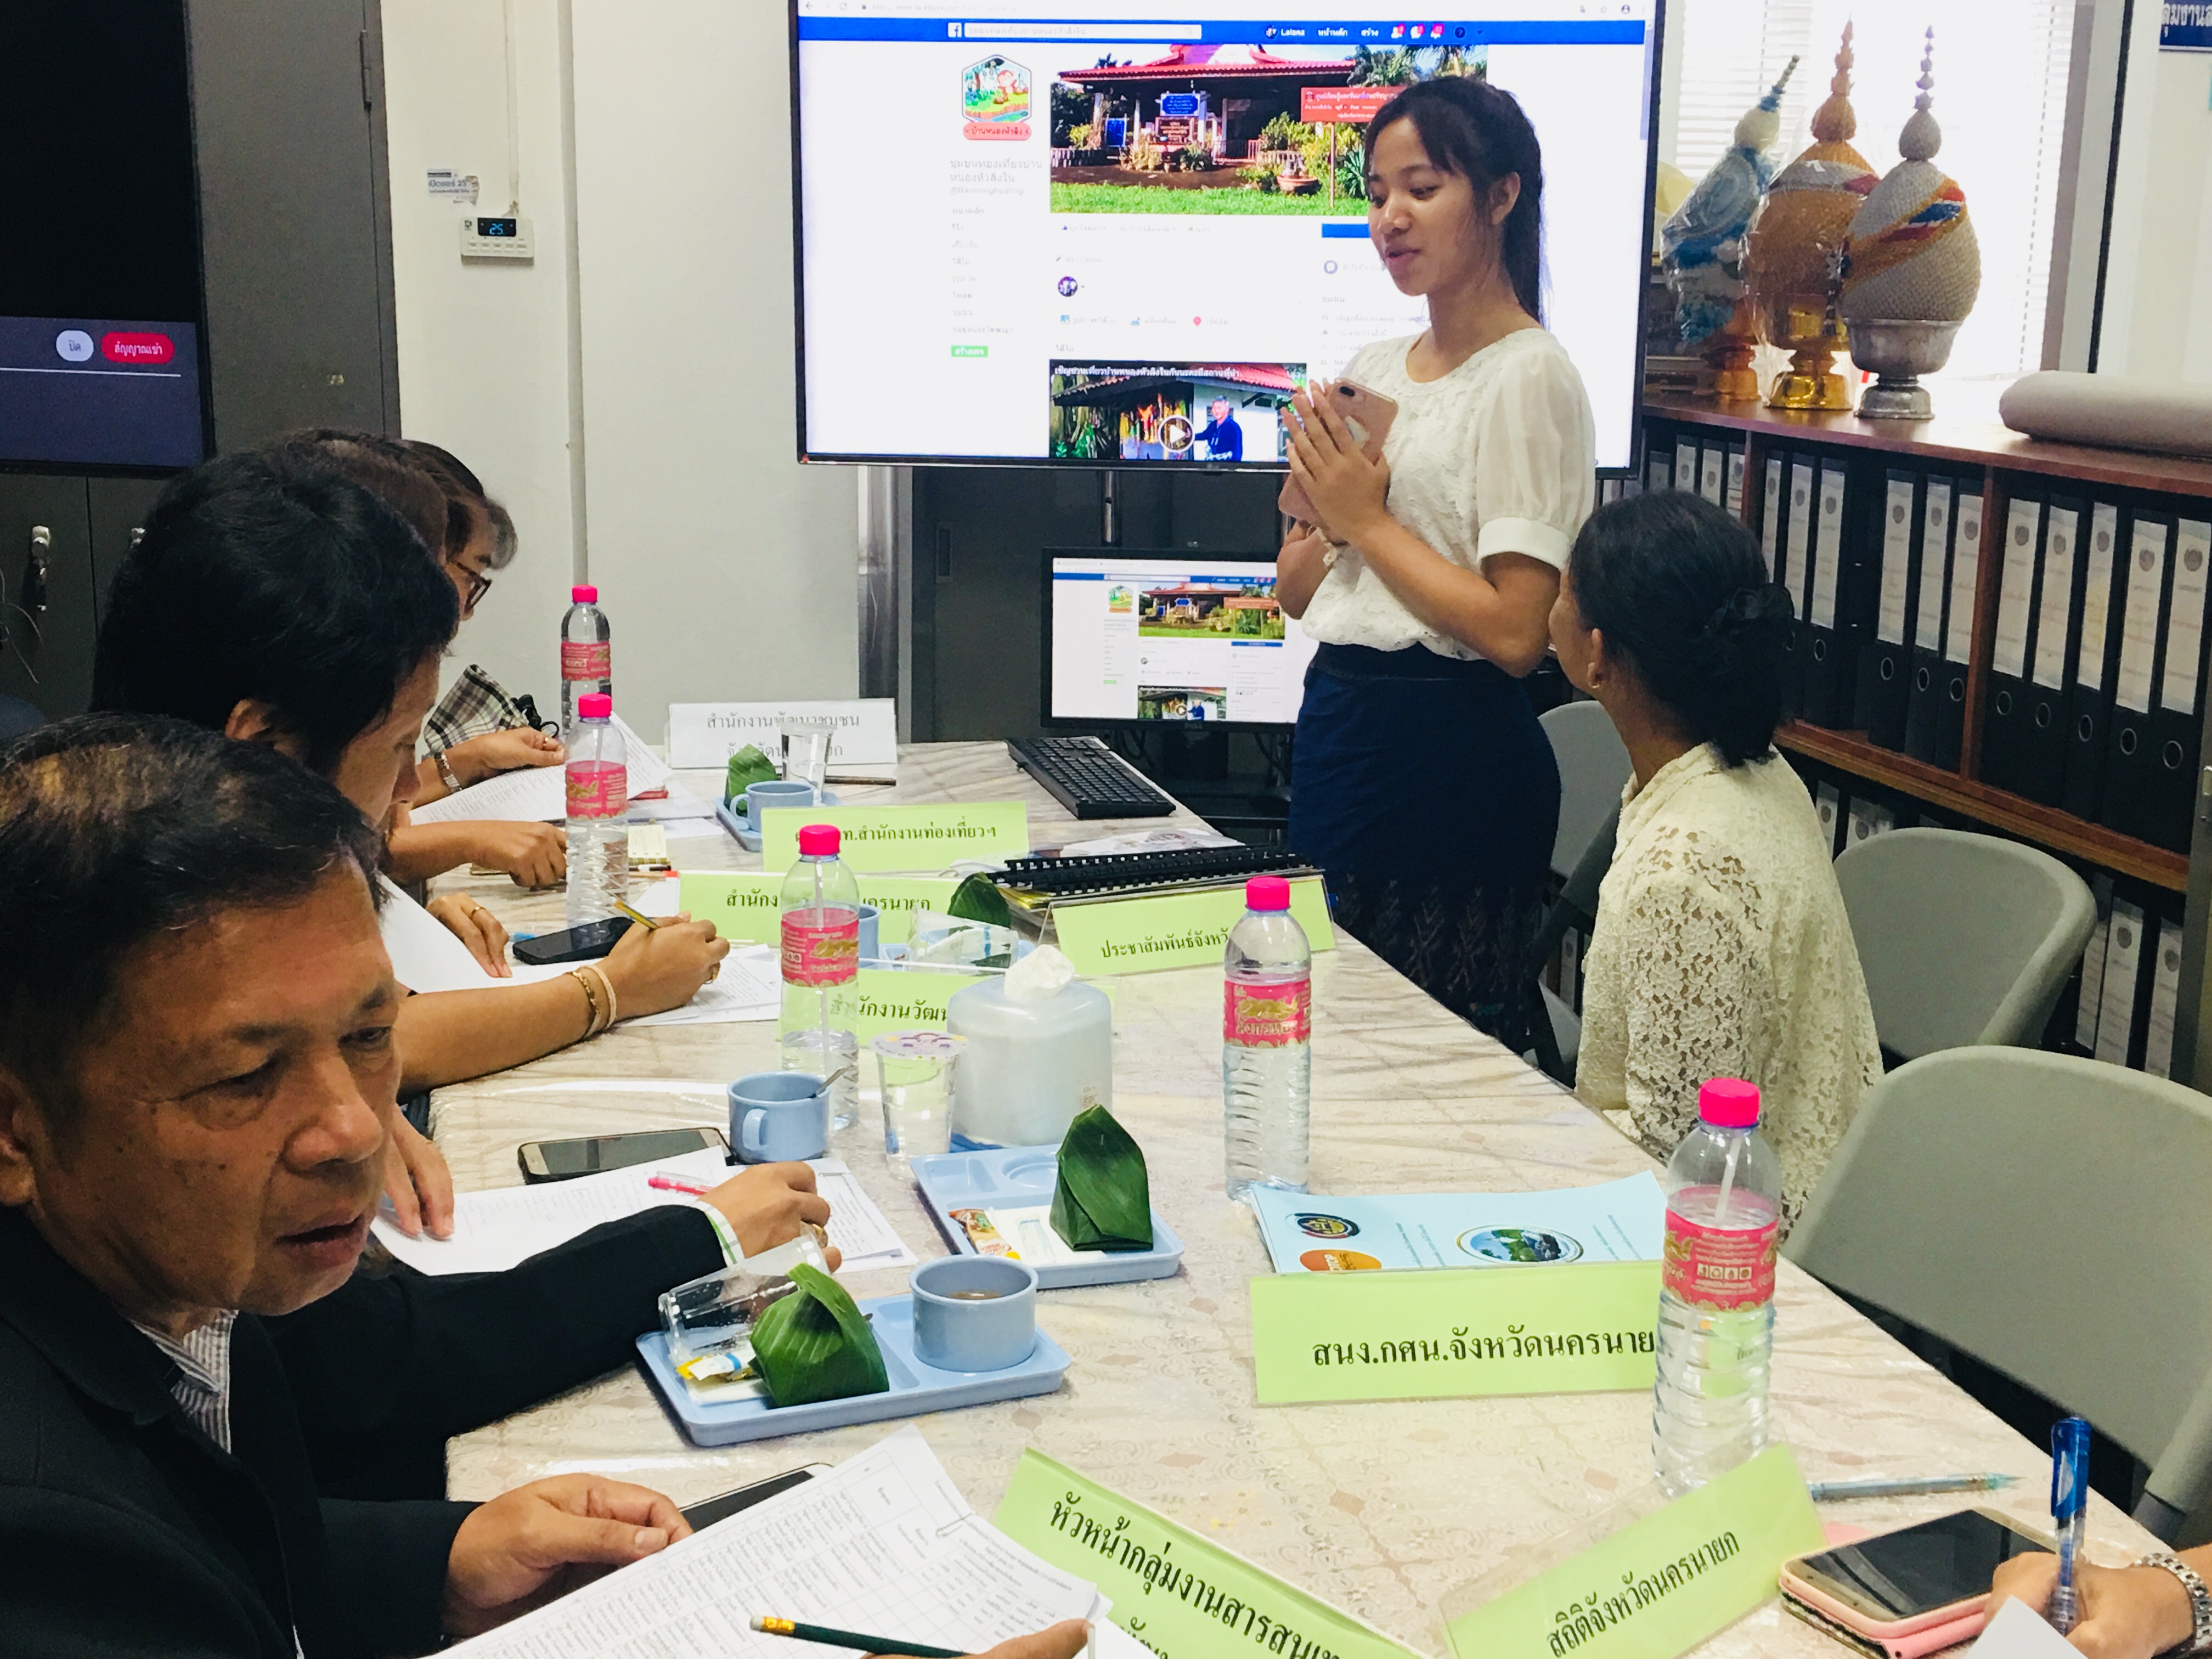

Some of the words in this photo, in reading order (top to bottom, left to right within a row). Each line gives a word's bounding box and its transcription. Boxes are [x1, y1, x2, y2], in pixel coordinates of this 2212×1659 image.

[489, 223, 503, 235] 25
[69, 339, 81, 352] ปิด
[1312, 1324, 1655, 1367] สนง.กศน.จังหวัดนครนาย
[1049, 1491, 1340, 1659] หัวหน้ากลุ่มงานสารสน
[1546, 1530, 1741, 1658] สถิติจังหวัดนครนายก
